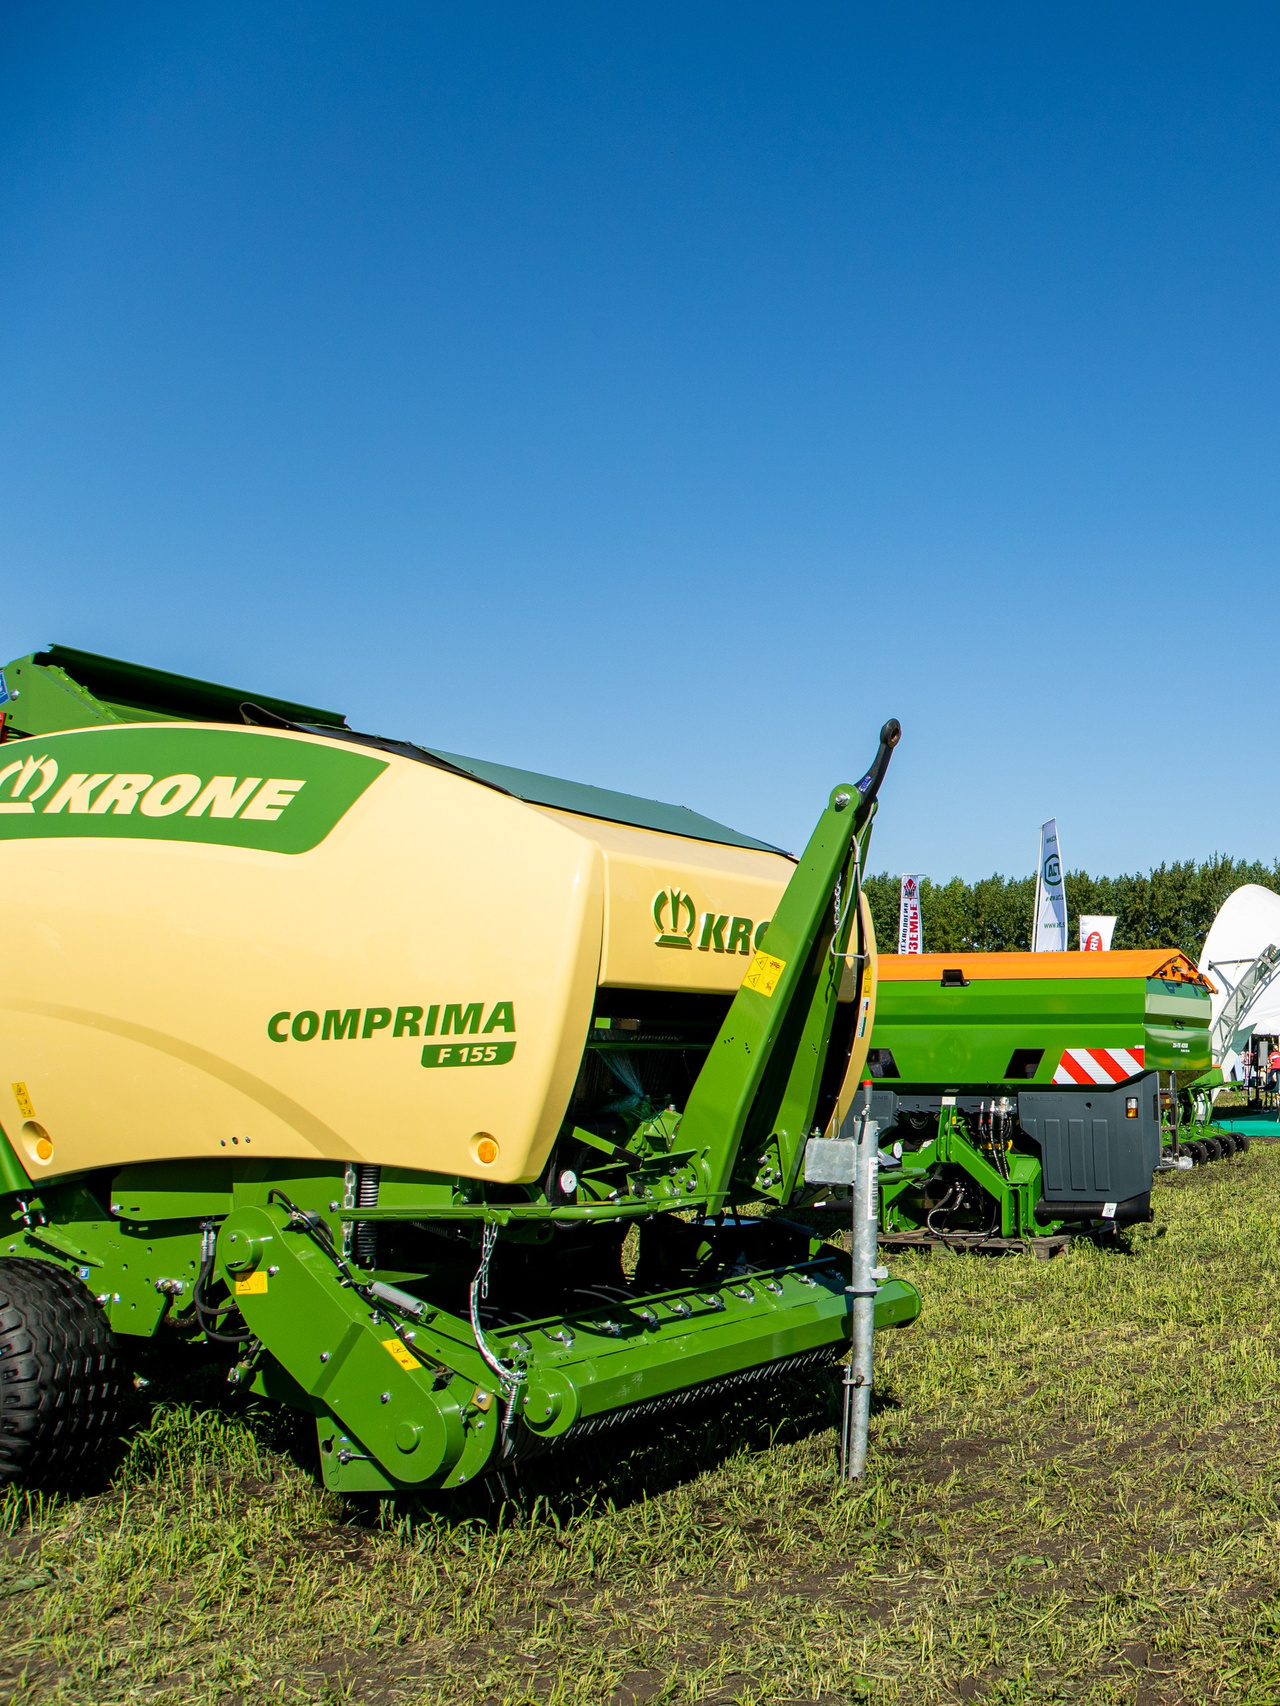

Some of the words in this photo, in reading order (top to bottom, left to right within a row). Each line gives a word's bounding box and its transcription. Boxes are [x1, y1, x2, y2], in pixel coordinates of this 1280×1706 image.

[42, 773, 307, 821] KRONE
[1090, 934, 1100, 951] RN
[267, 1001, 517, 1043] COMPRIMA
[437, 1048, 453, 1064] F
[458, 1046, 499, 1063] 155
